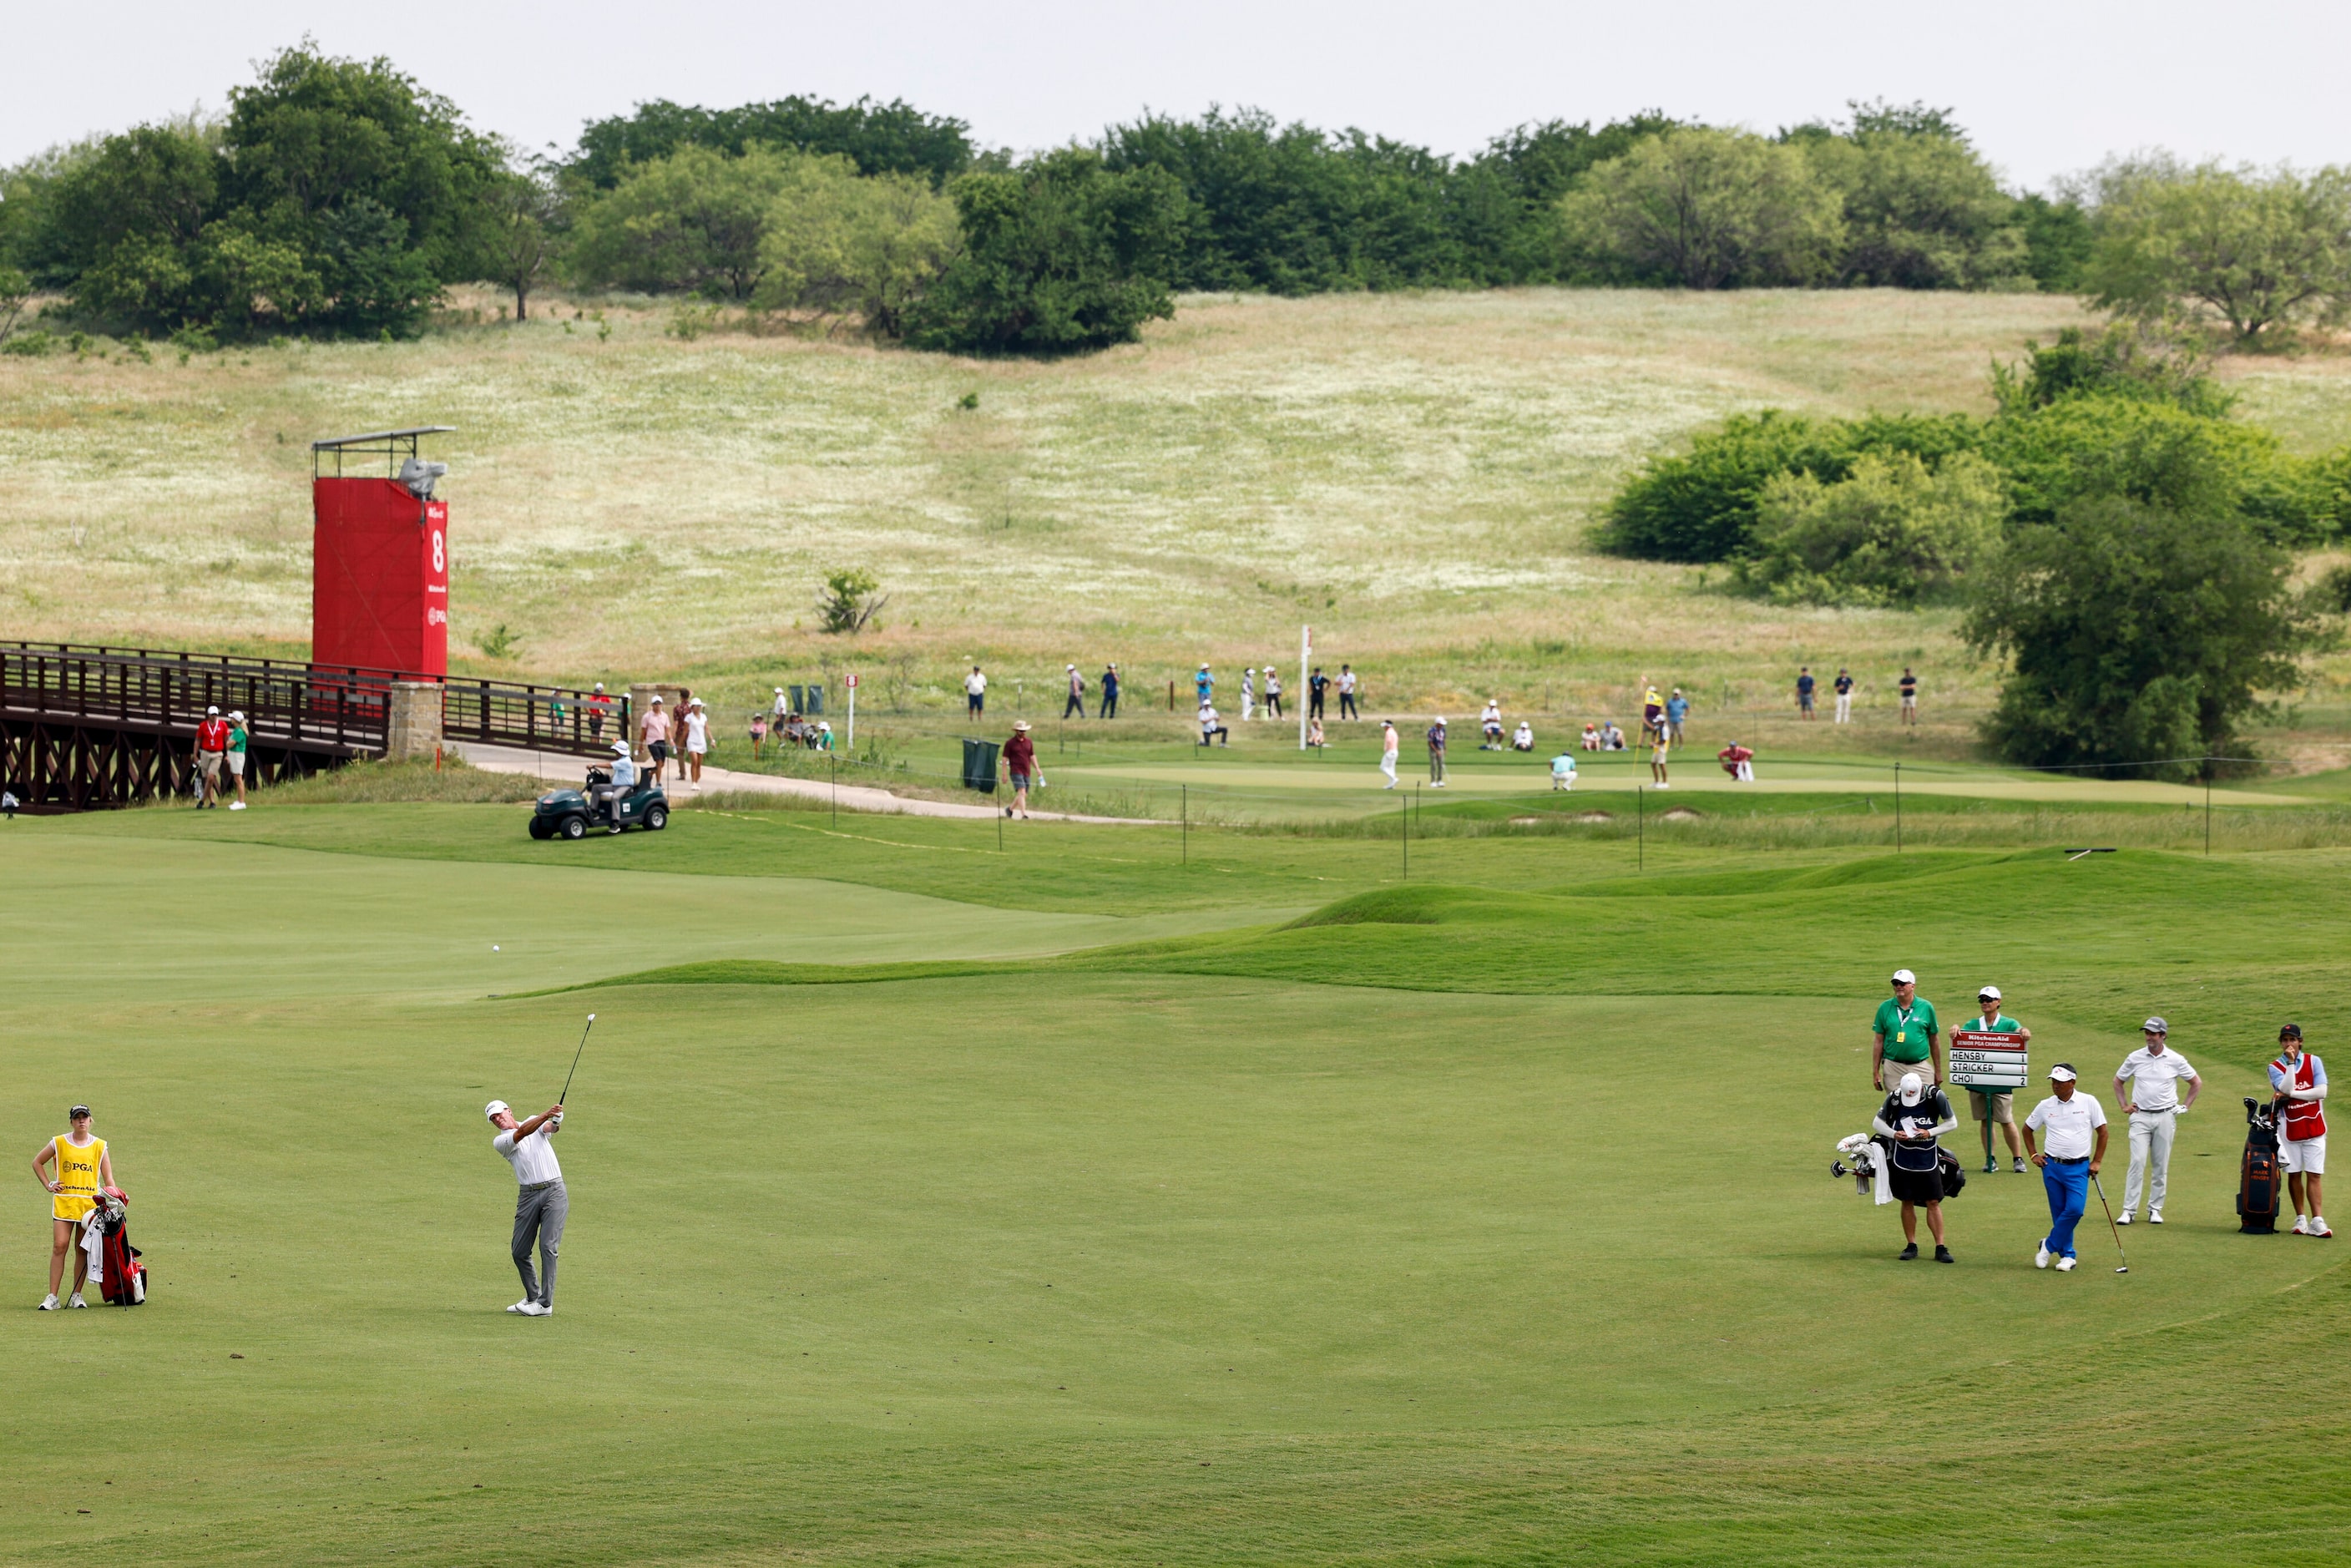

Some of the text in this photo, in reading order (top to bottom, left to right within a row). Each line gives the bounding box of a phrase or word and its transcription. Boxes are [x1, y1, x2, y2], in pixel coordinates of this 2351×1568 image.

[432, 529, 444, 574] 8
[1952, 1052, 1986, 1060] HENSBY
[1952, 1063, 1994, 1072] STRICKER
[1952, 1075, 2025, 1085] CHOI 2
[72, 1163, 93, 1172] PGA
